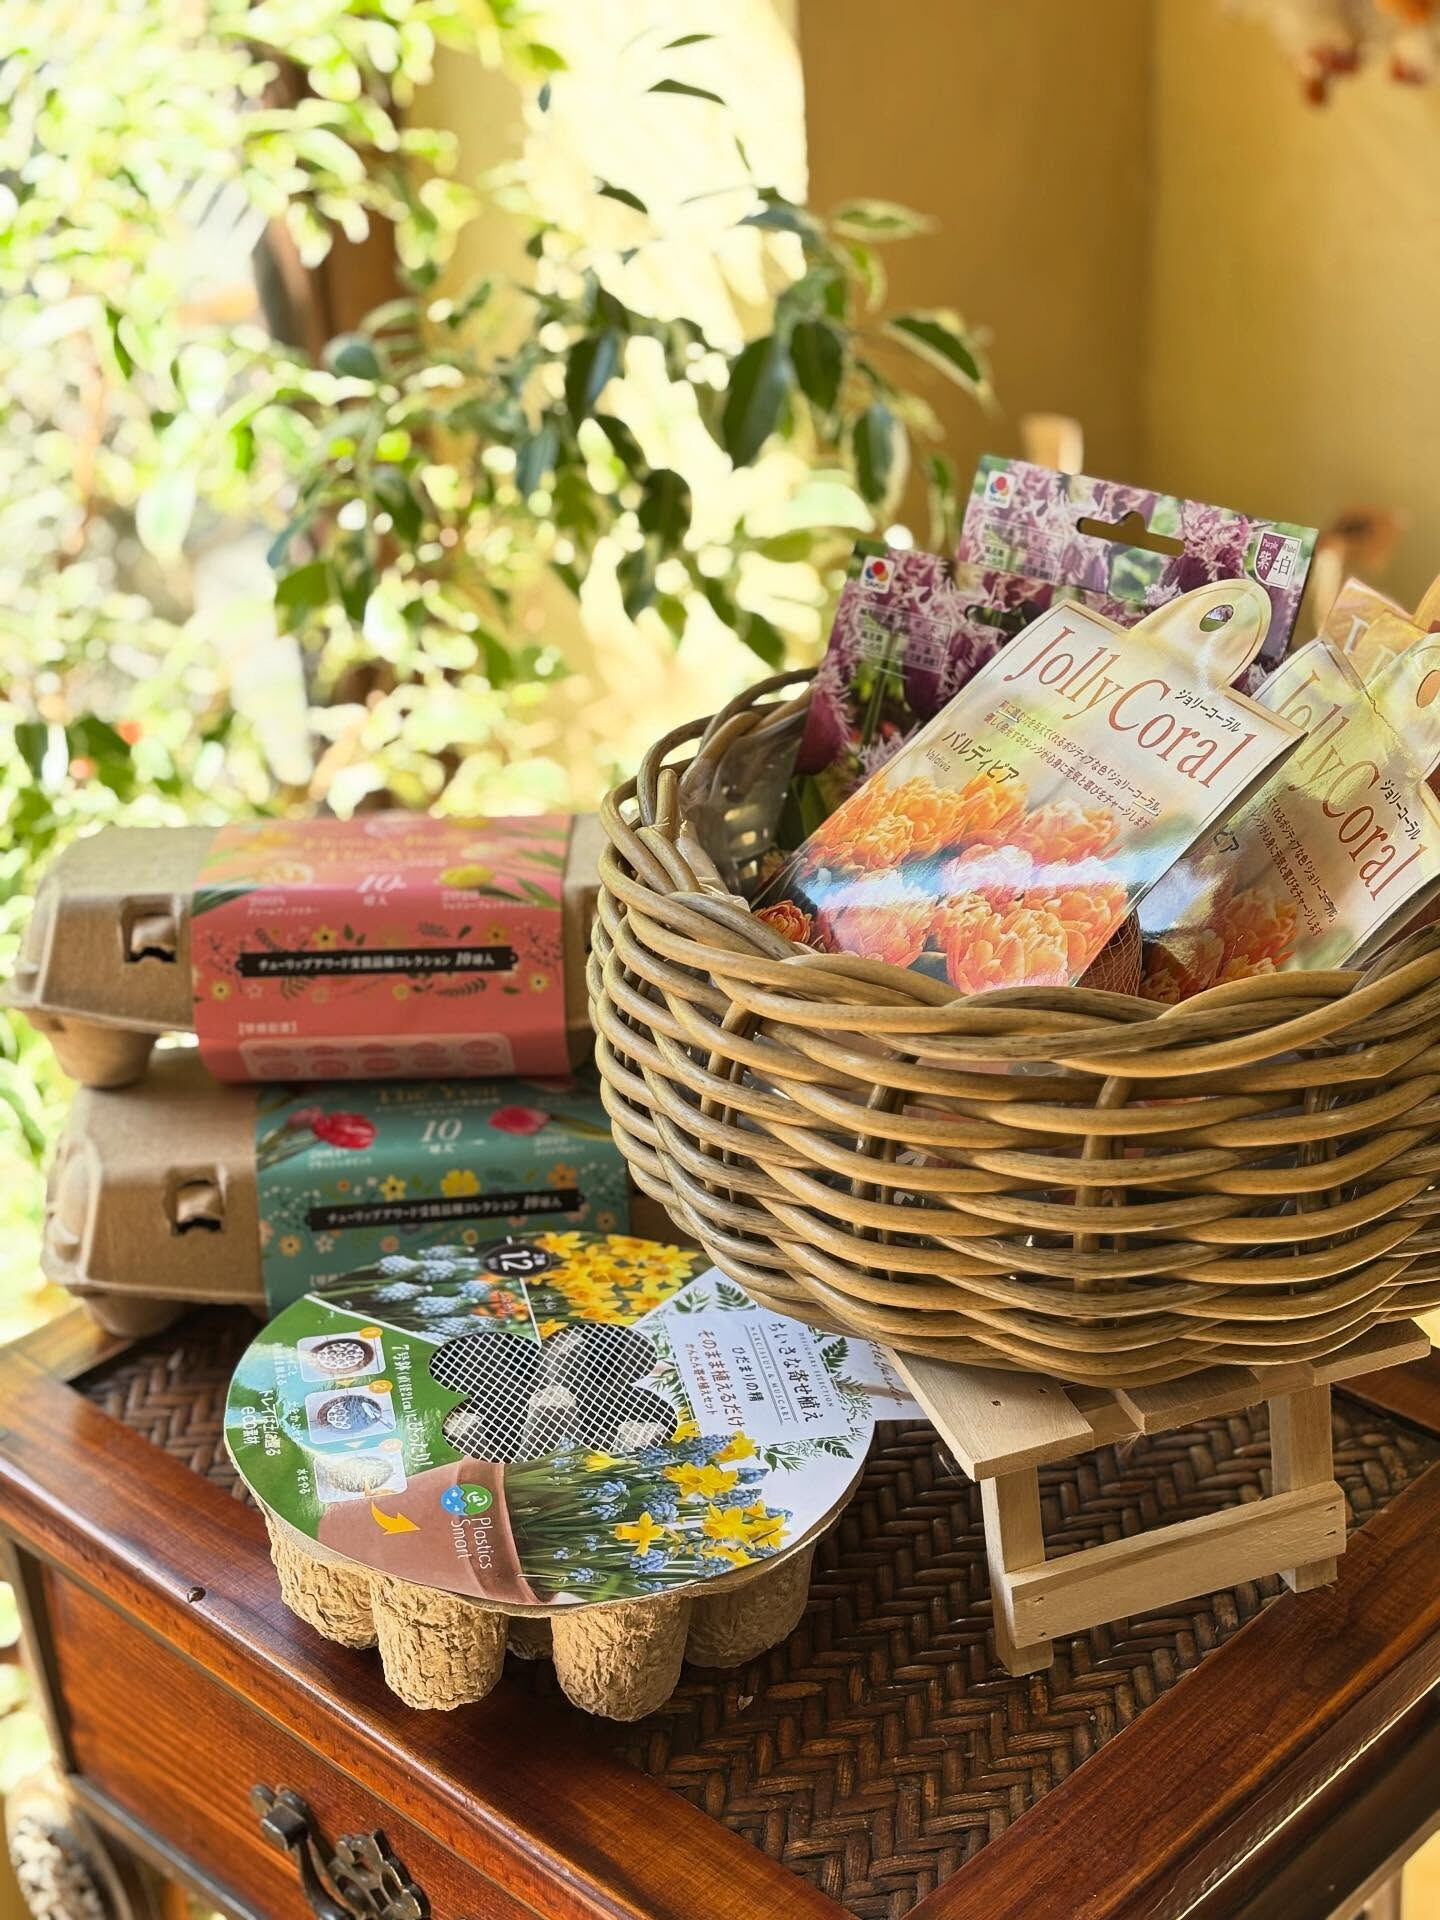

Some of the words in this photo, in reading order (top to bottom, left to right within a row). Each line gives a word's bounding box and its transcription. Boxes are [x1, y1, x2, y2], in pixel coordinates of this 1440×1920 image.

[1174, 688, 1242, 734] ジョリーコーラル
[925, 748, 951, 773] Valdivia
[1379, 779, 1421, 841] ジョリーコーラル
[500, 1250, 533, 1271] 12
[697, 1329, 747, 1428] そのまま植えるだけ
[731, 1346, 765, 1402] ひだまりの精
[768, 1322, 824, 1422] ちいさな寄せ植え
[450, 1518, 473, 1560] Smart
[471, 1517, 494, 1570] Plastics
